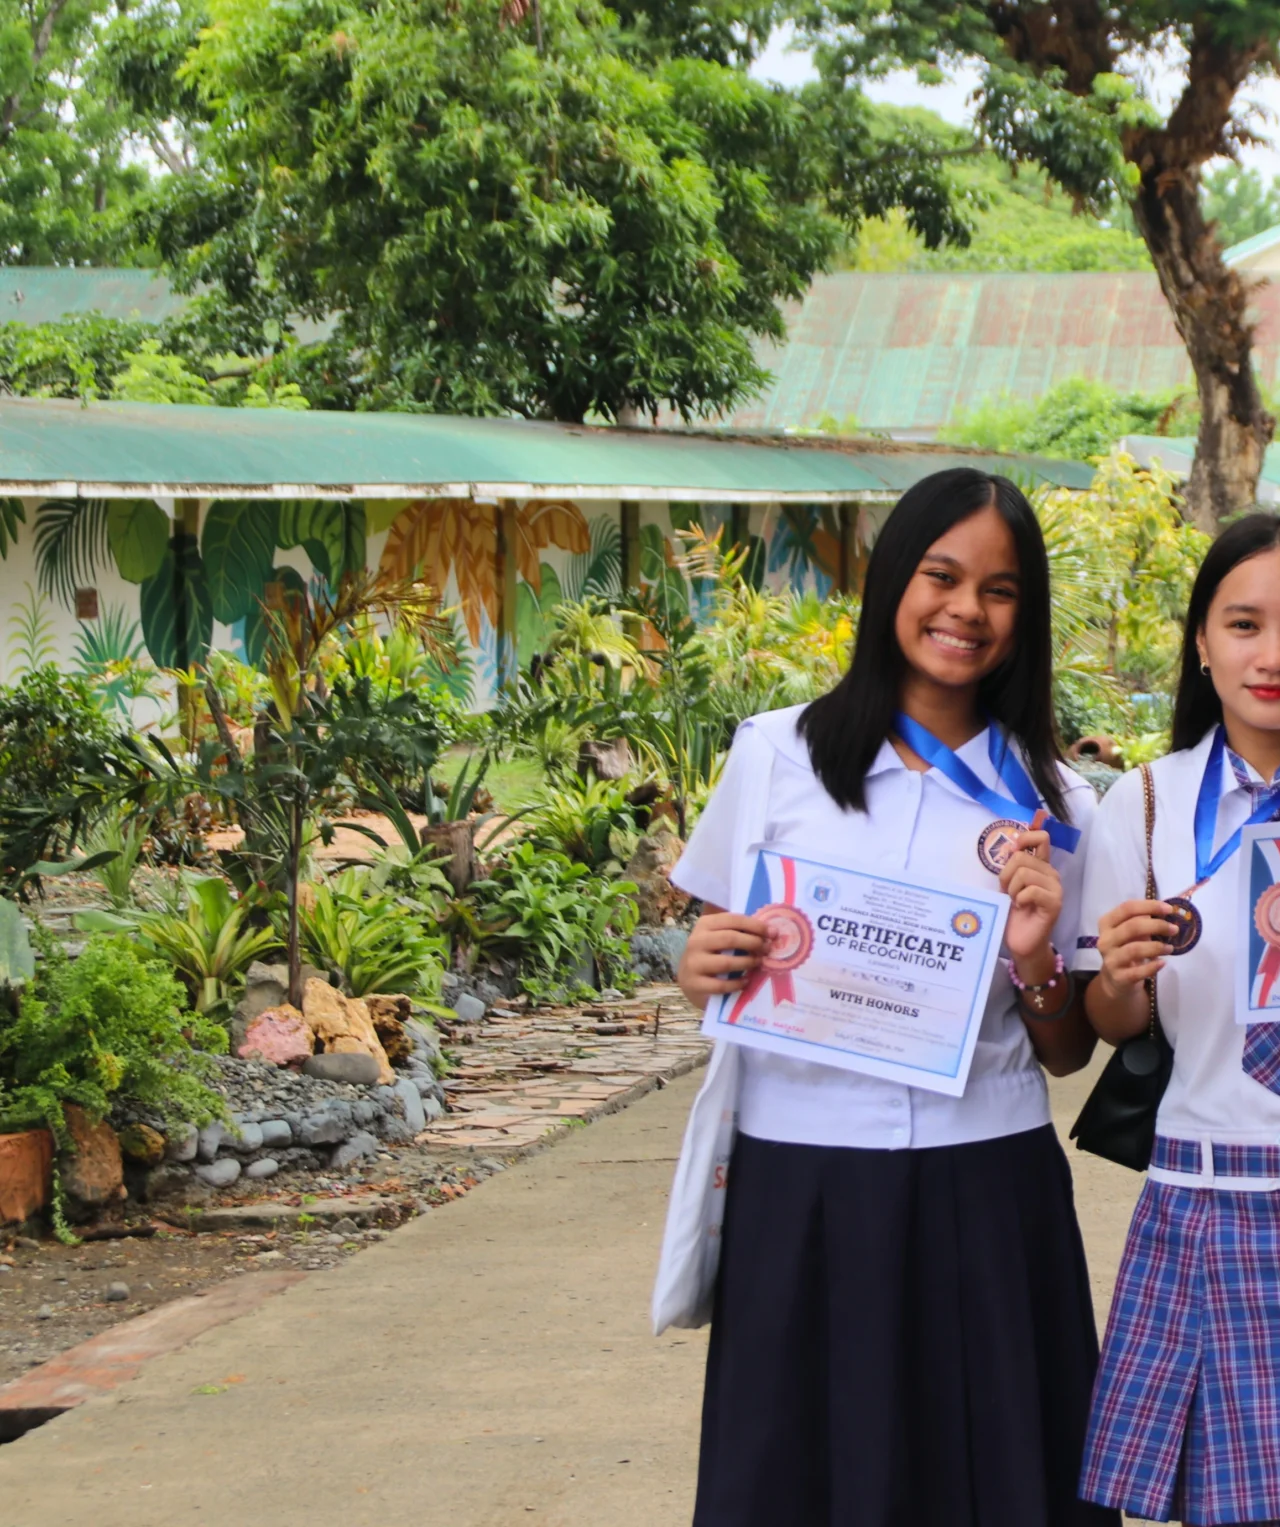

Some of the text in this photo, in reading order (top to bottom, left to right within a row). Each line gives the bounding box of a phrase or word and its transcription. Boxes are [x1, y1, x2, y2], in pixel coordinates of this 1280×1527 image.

[816, 914, 965, 962] CERTIFICATE
[826, 934, 848, 950] OF
[848, 940, 948, 972] RECOGNITION
[830, 989, 920, 1018] WITH HONORS
